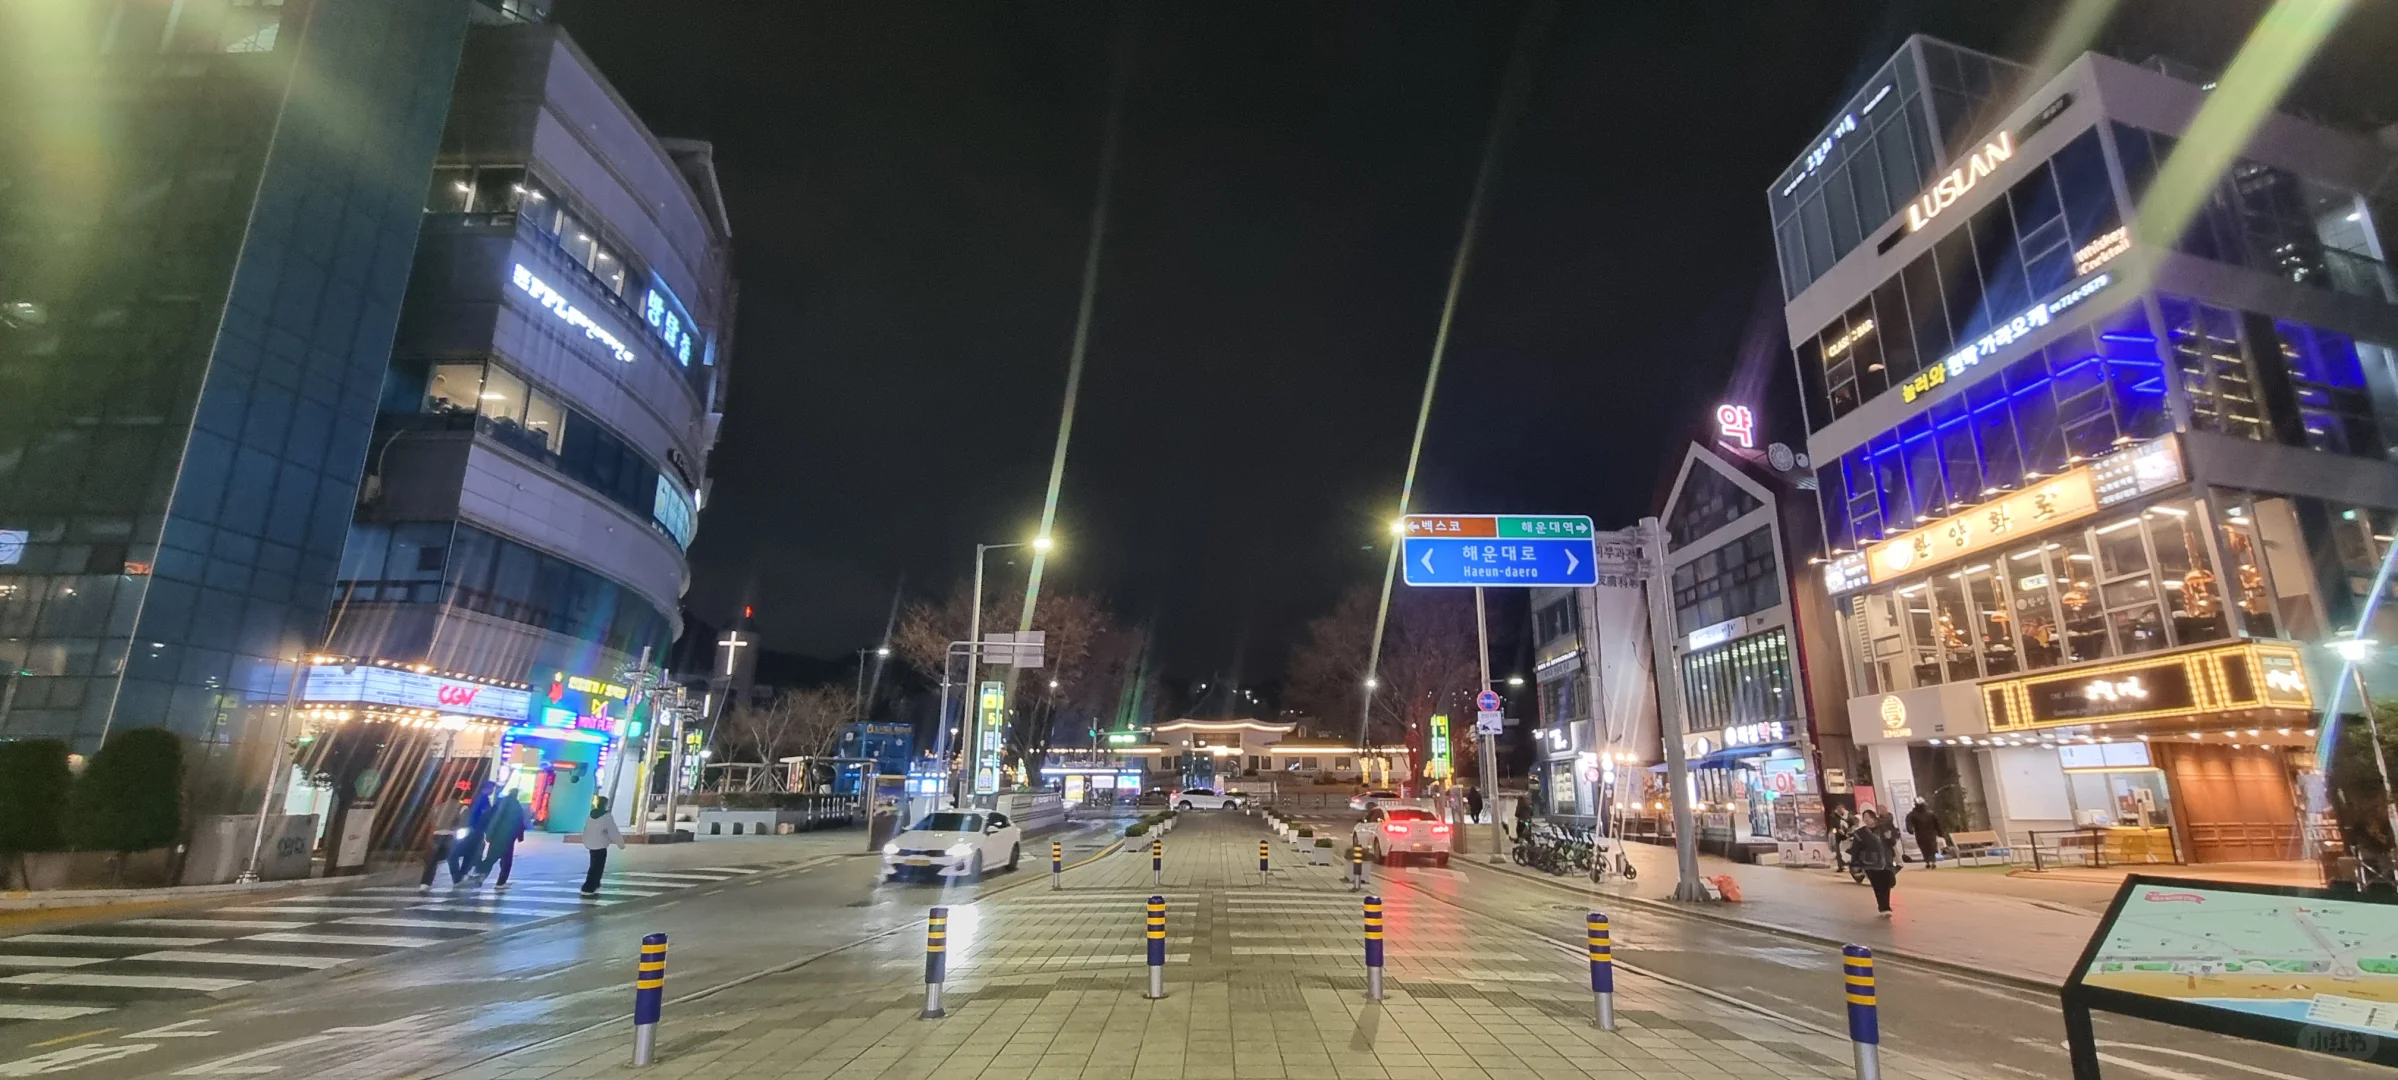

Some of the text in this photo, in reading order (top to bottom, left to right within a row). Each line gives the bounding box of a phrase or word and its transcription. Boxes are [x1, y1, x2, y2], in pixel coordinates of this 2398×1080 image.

[1907, 130, 2014, 232] LUSLAN
[1717, 404, 1753, 448] 약
[1421, 520, 1461, 533] 벡스코
[1521, 520, 1574, 535] 해운대역
[1462, 545, 1537, 564] 해운대로
[1463, 566, 1538, 578] Haeun-daero
[438, 684, 476, 706] CGV
